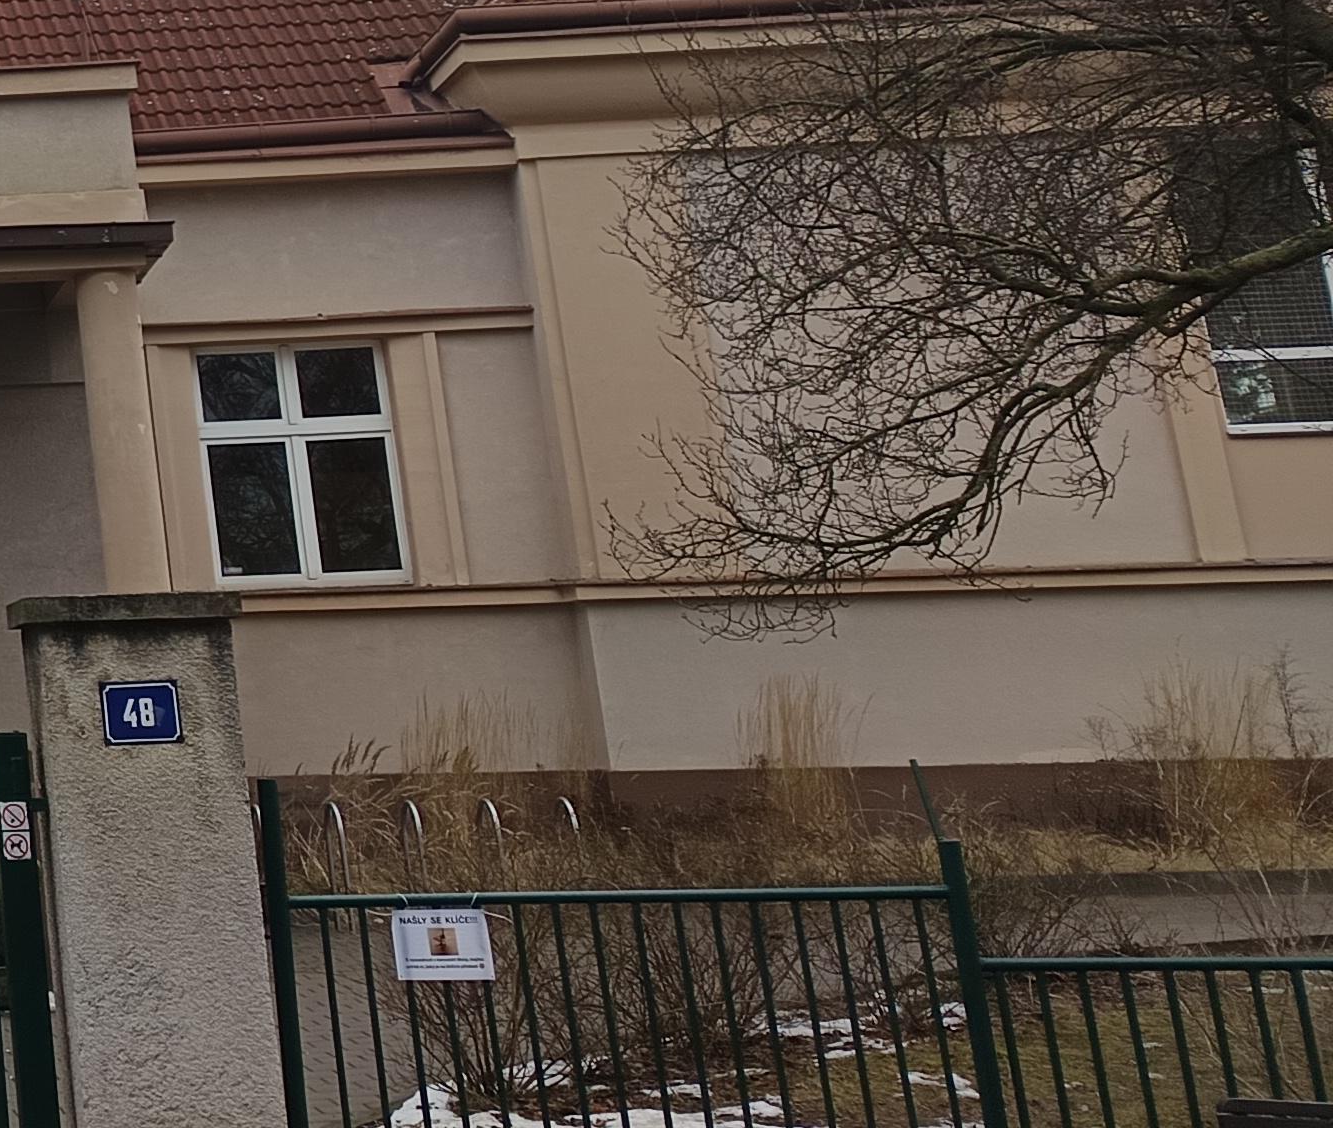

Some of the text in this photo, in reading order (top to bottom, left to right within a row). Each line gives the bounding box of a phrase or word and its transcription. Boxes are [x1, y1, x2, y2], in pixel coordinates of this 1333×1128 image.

[123, 697, 155, 728] 48
[399, 915, 428, 925] NAŠLY
[430, 916, 442, 924] SE
